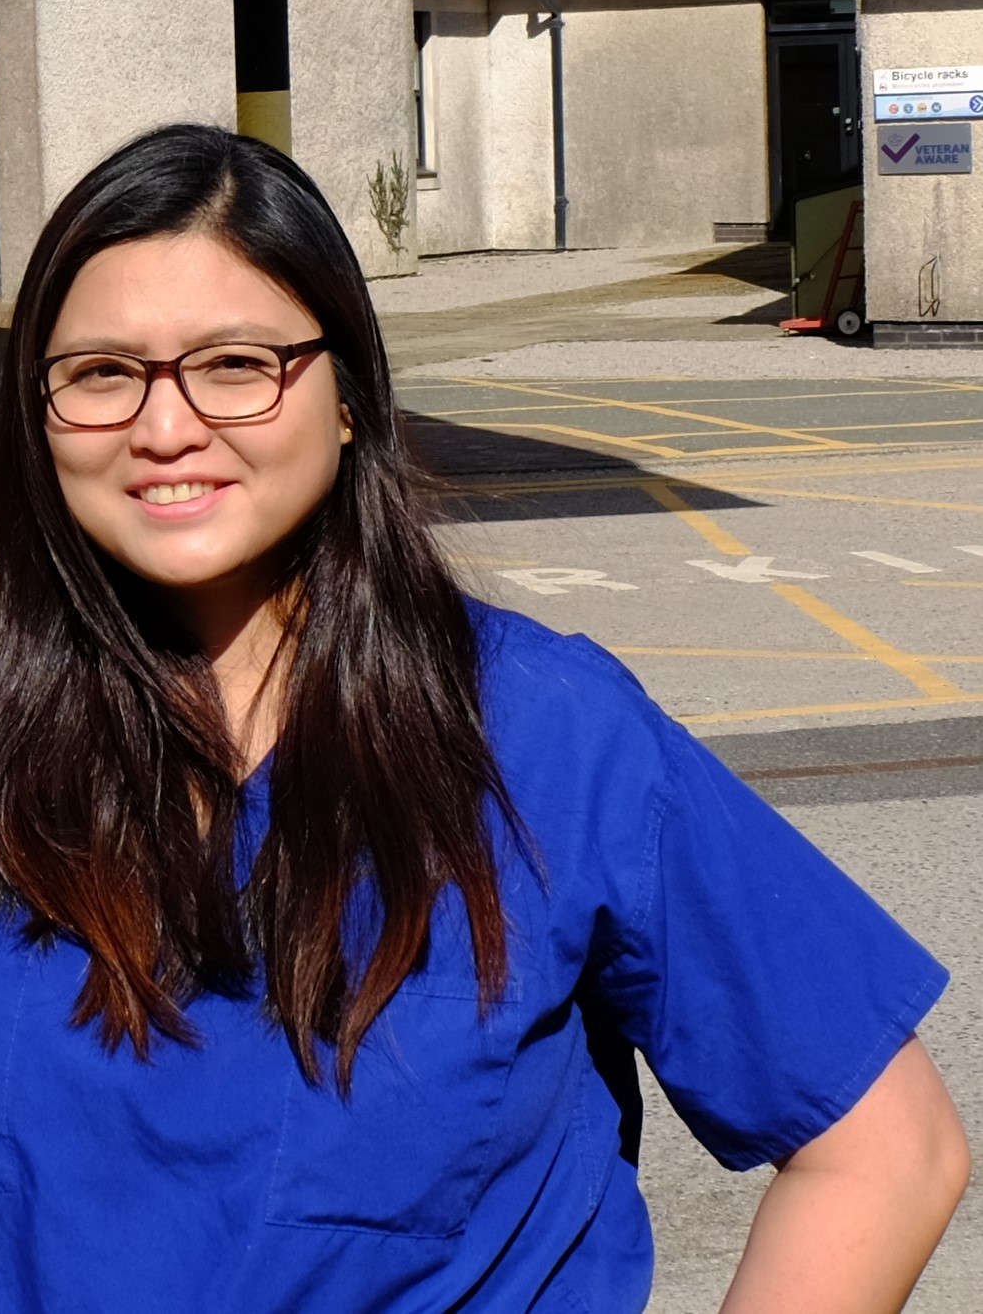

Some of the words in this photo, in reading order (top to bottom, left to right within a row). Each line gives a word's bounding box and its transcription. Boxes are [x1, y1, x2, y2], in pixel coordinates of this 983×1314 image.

[891, 71, 934, 82] Bicycle
[937, 69, 968, 79] racks
[915, 144, 969, 154] VETERAN
[915, 154, 959, 165] AWARE
